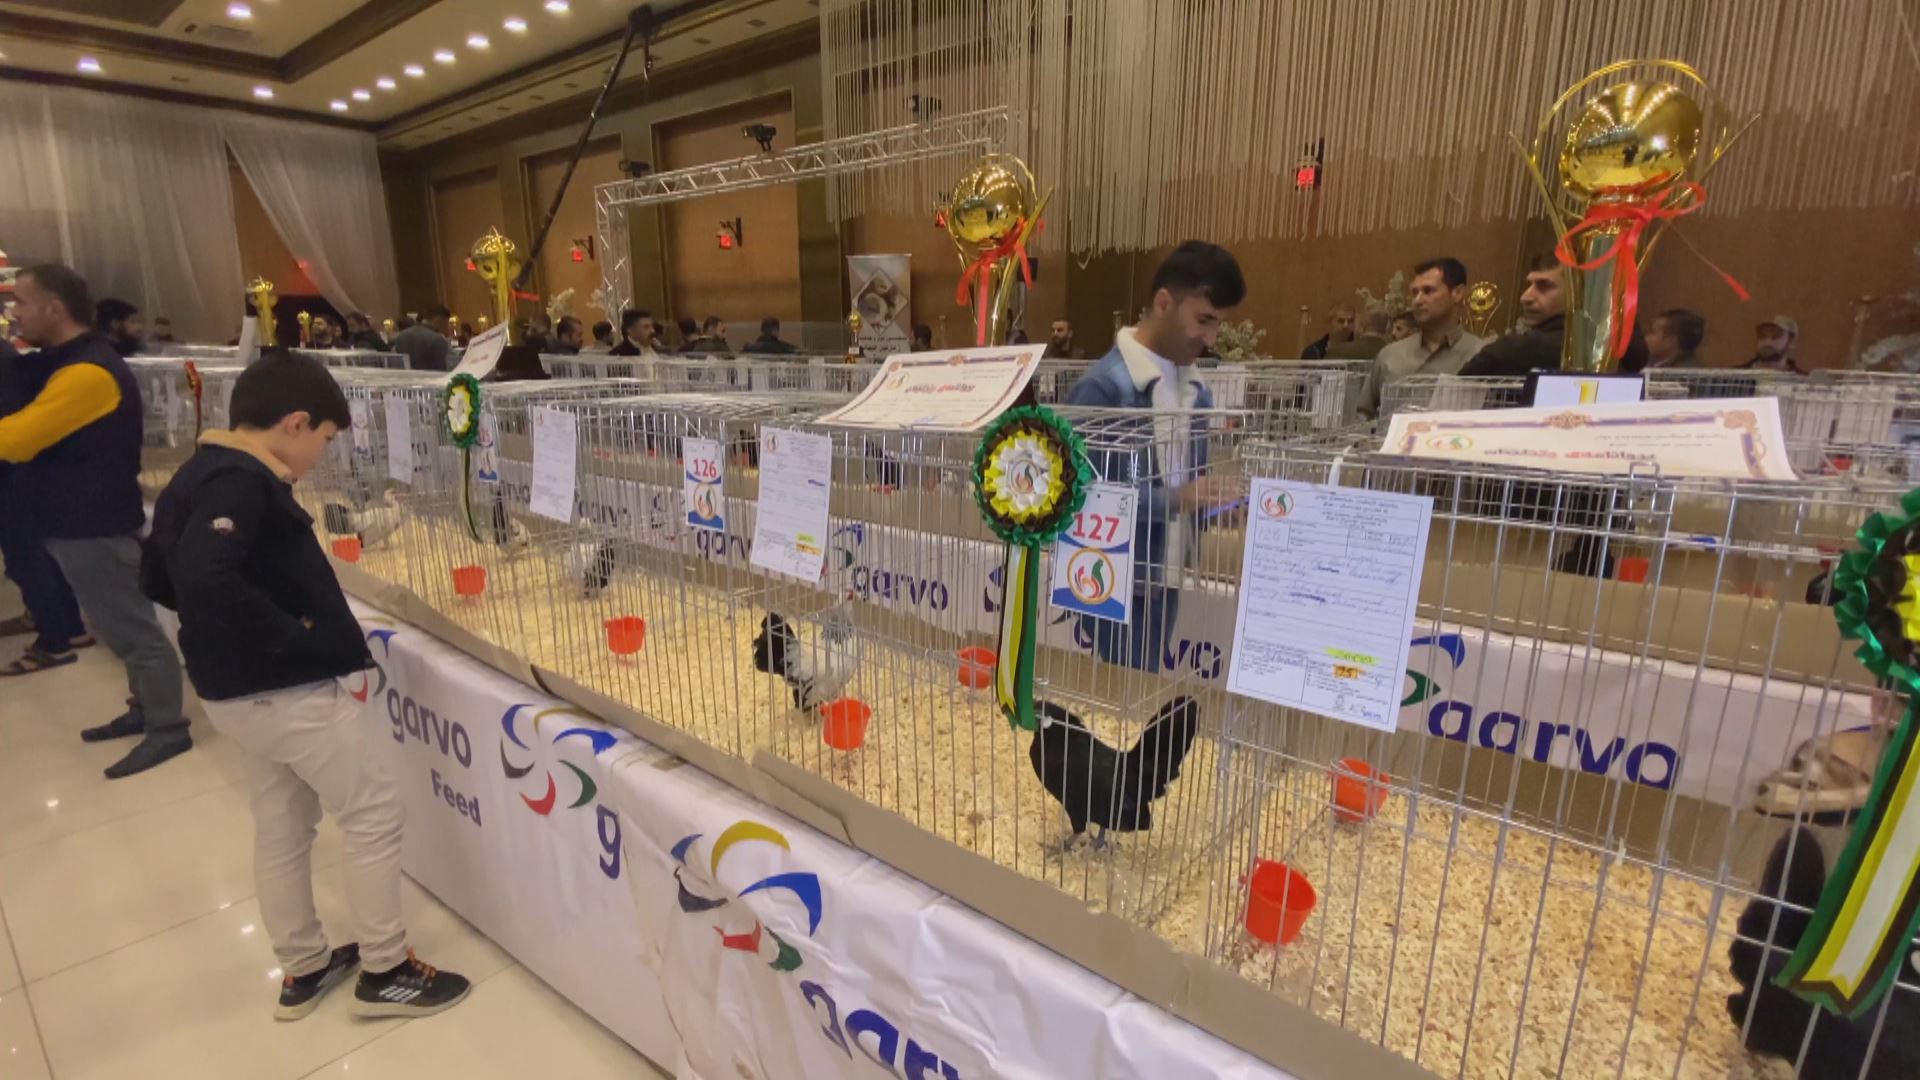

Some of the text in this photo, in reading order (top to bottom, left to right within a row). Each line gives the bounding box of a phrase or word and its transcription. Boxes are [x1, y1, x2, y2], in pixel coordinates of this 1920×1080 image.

[693, 458, 718, 479] 126
[1072, 511, 1121, 543] 127
[386, 687, 472, 769] garvo
[430, 767, 482, 828] Feed
